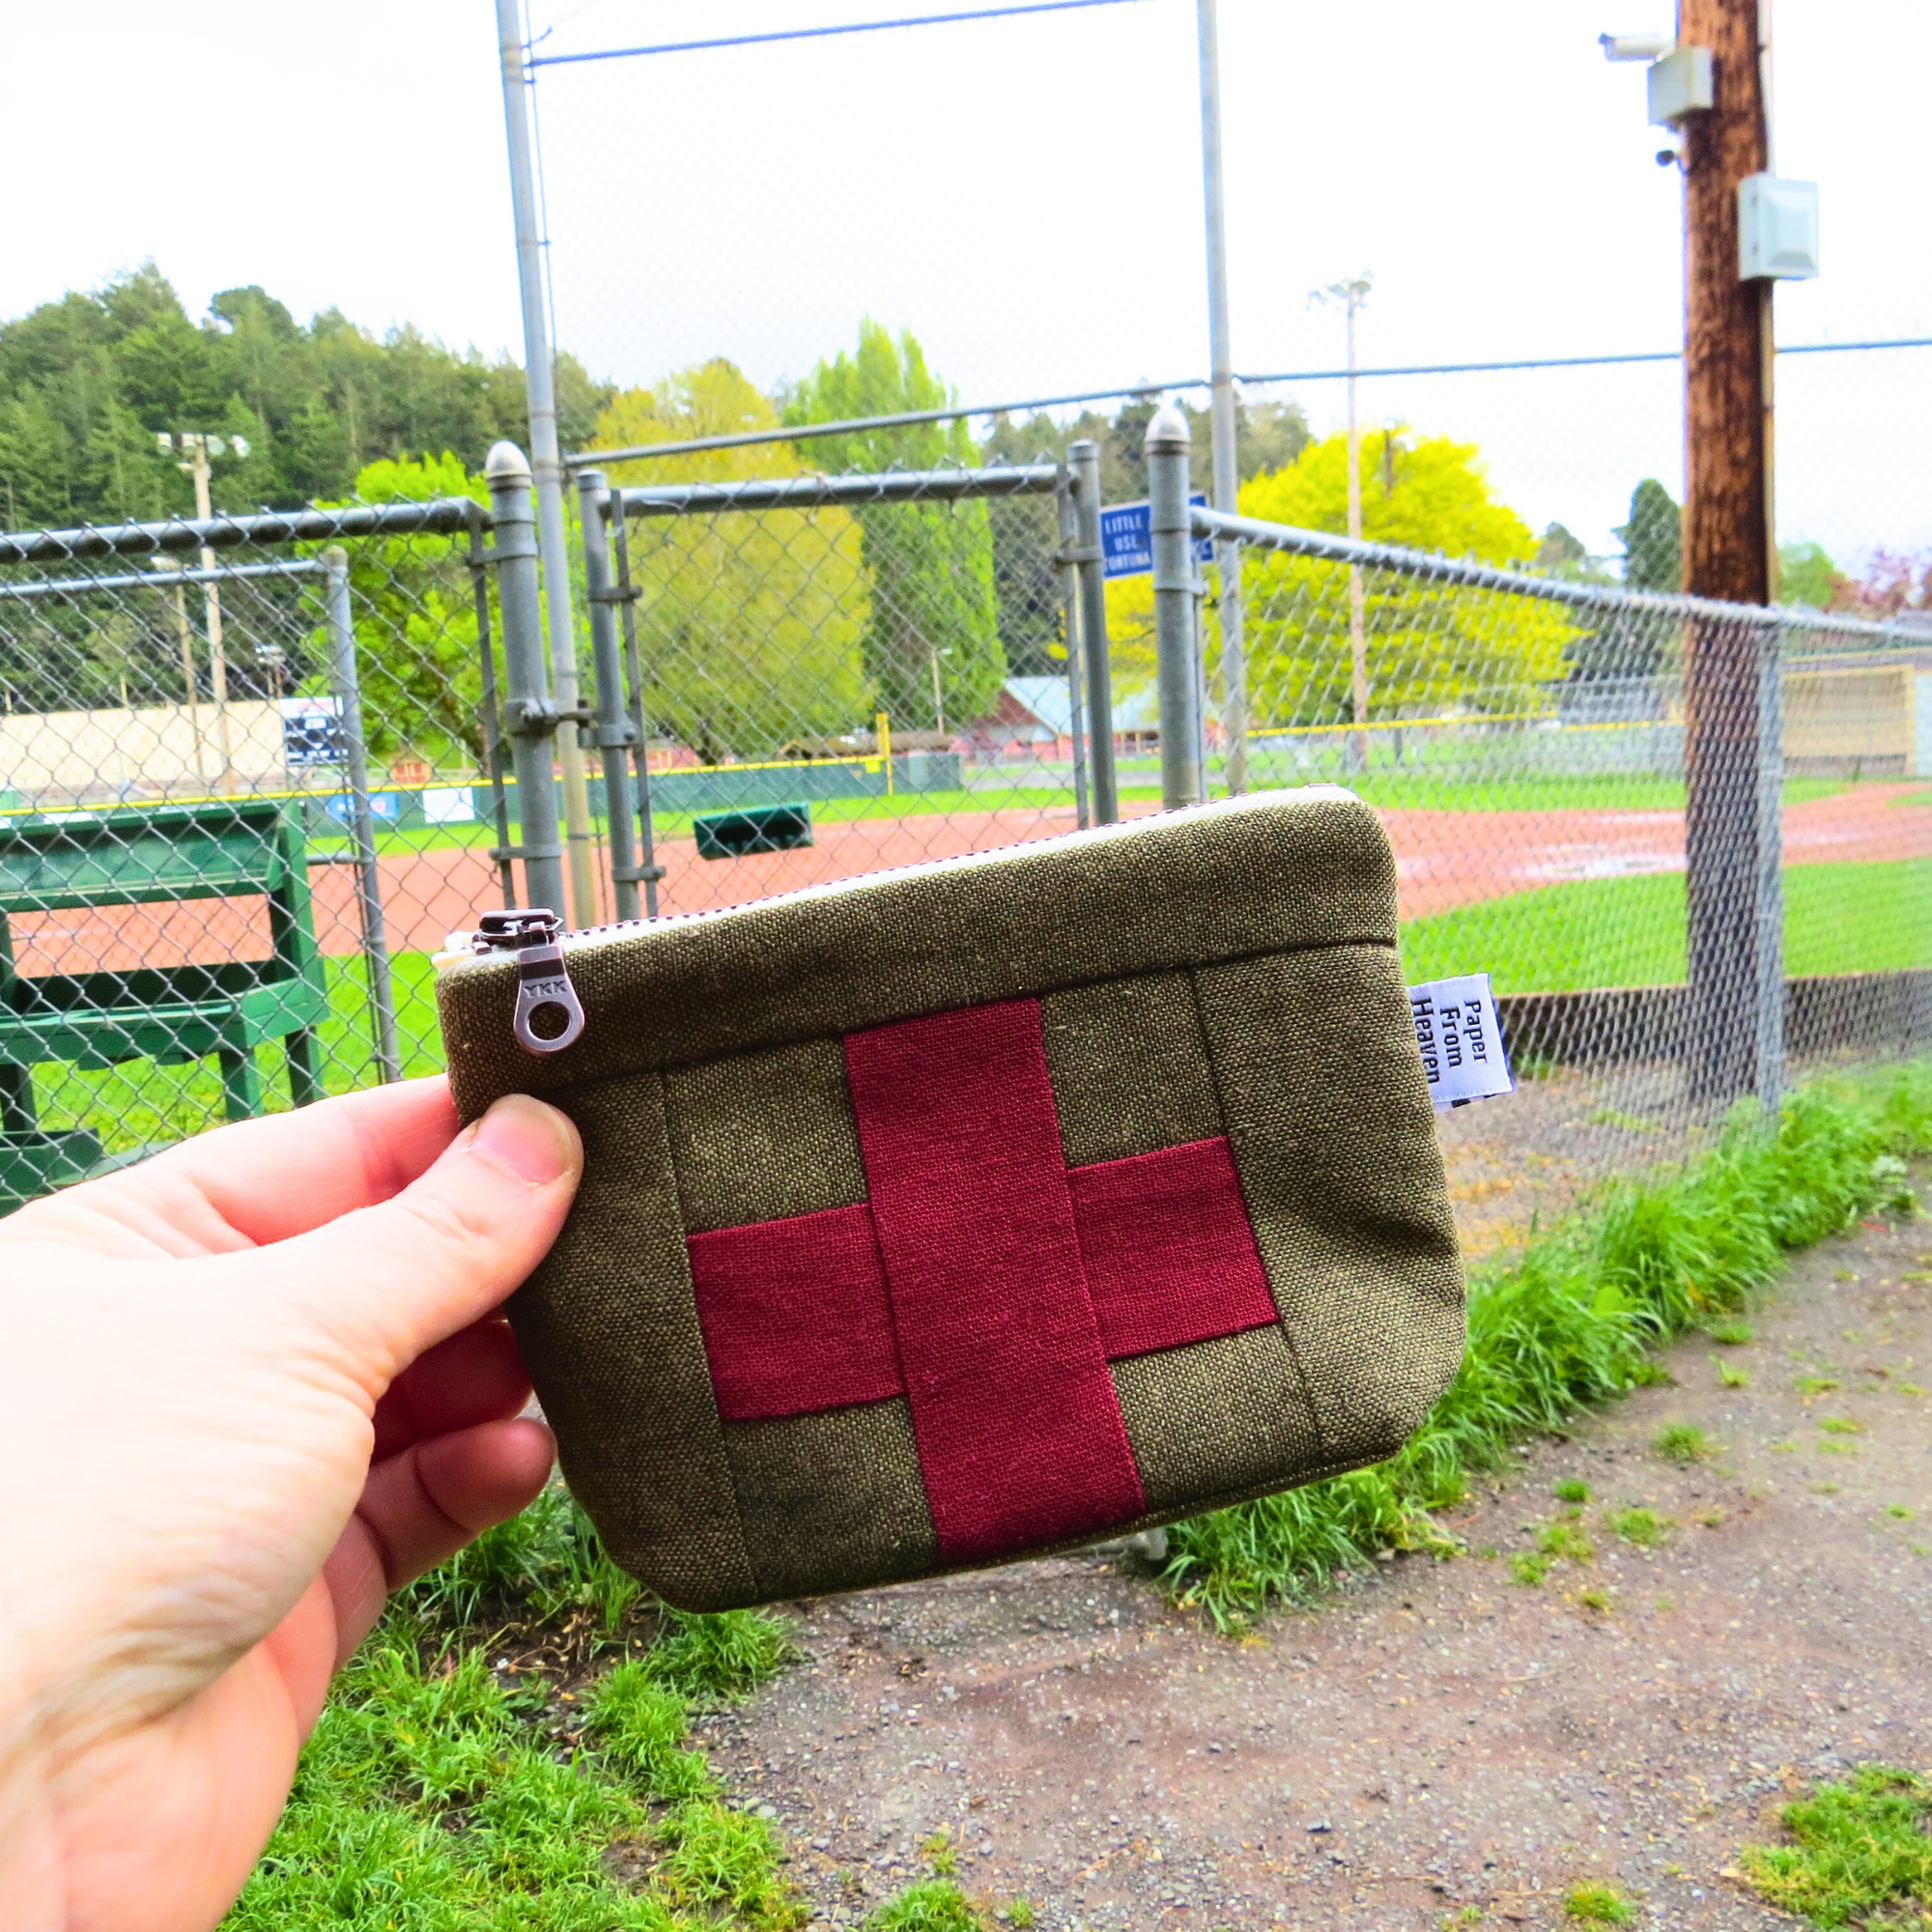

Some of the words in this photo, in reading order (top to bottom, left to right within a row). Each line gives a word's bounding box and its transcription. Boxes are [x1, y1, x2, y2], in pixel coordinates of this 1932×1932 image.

[524, 980, 567, 998] YKK
[1410, 997, 1440, 1084] Heaven
[1440, 1006, 1463, 1068] From
[1463, 999, 1488, 1064] Paper
